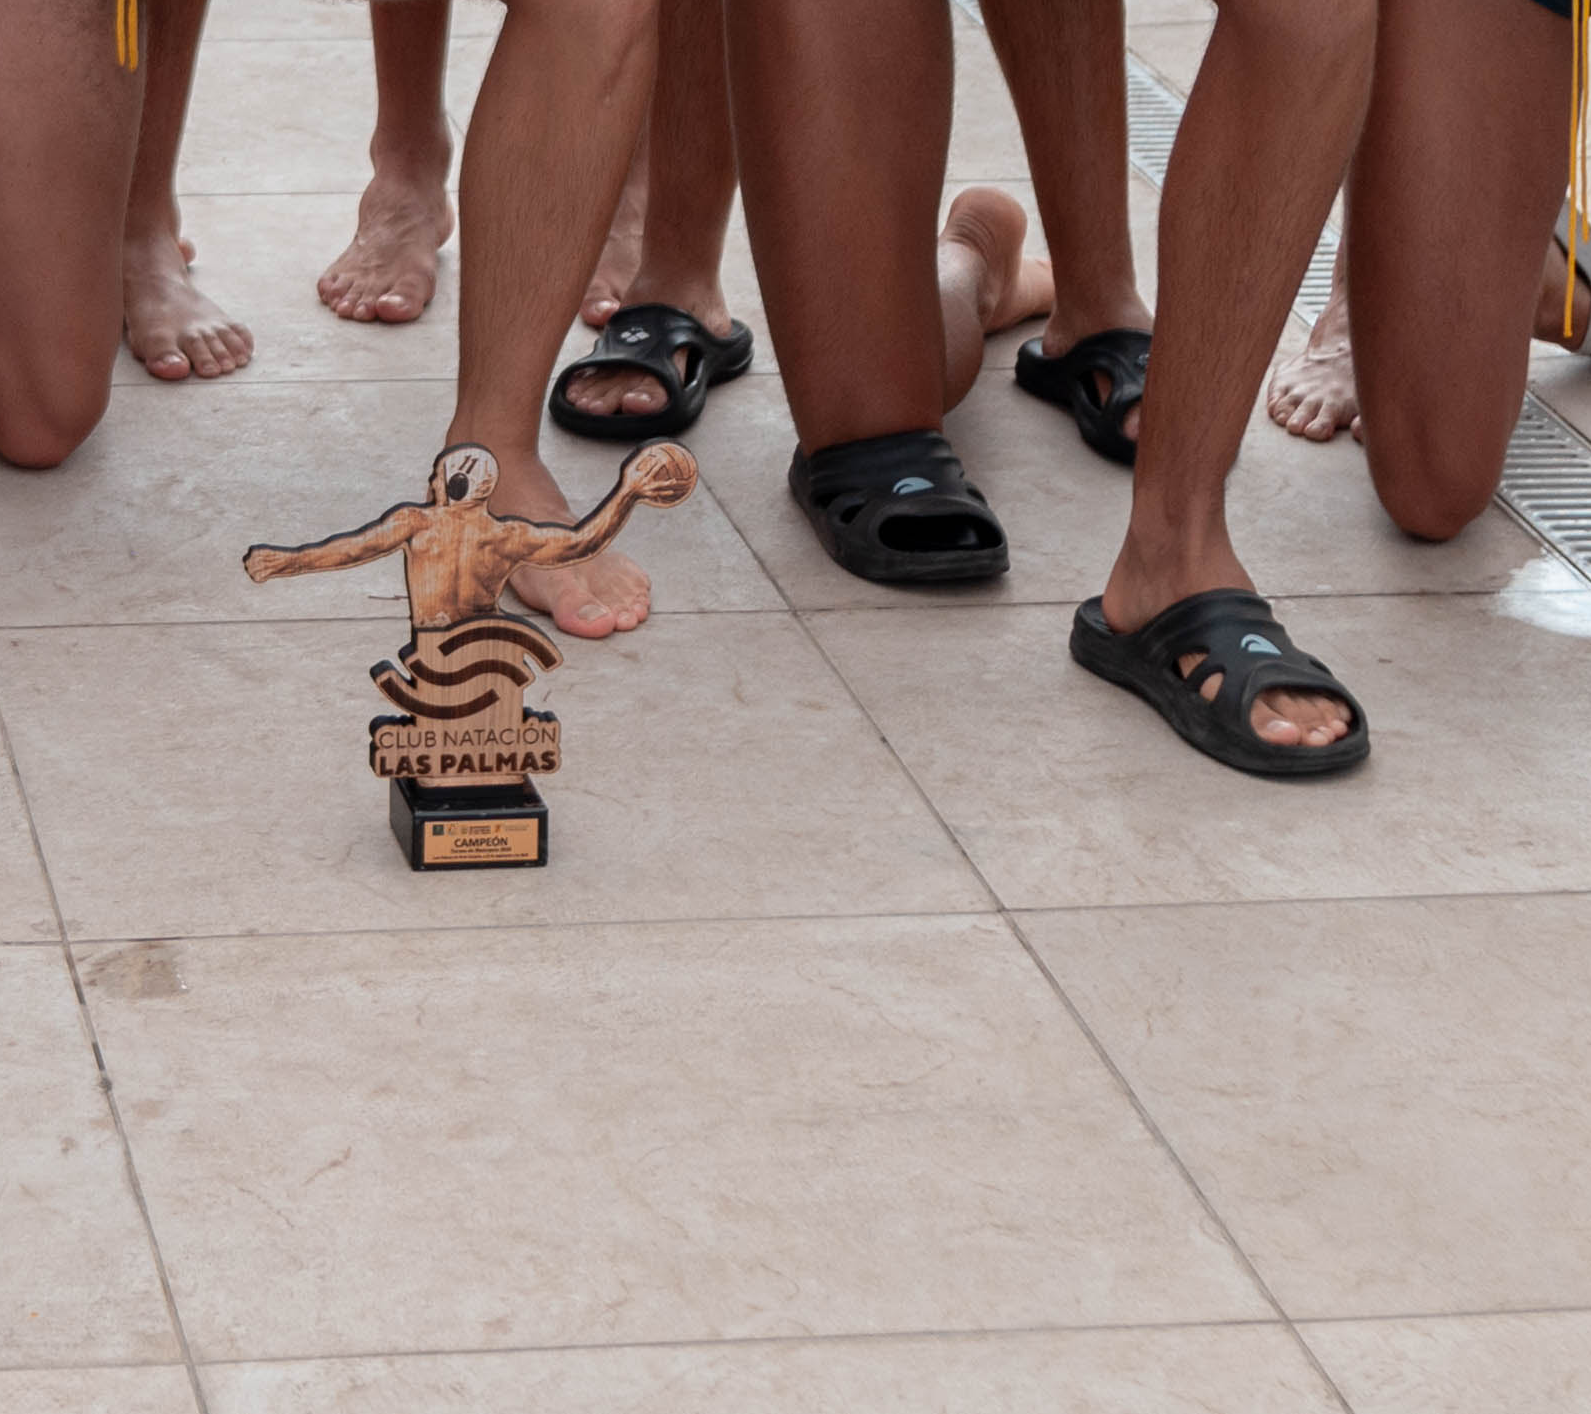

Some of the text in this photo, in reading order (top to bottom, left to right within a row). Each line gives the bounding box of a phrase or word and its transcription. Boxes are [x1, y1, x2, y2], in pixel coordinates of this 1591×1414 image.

[379, 722, 556, 749] CLUB NATACIÓN
[379, 750, 557, 775] LAS PALMAS
[454, 836, 508, 848] CAMPEÓN
